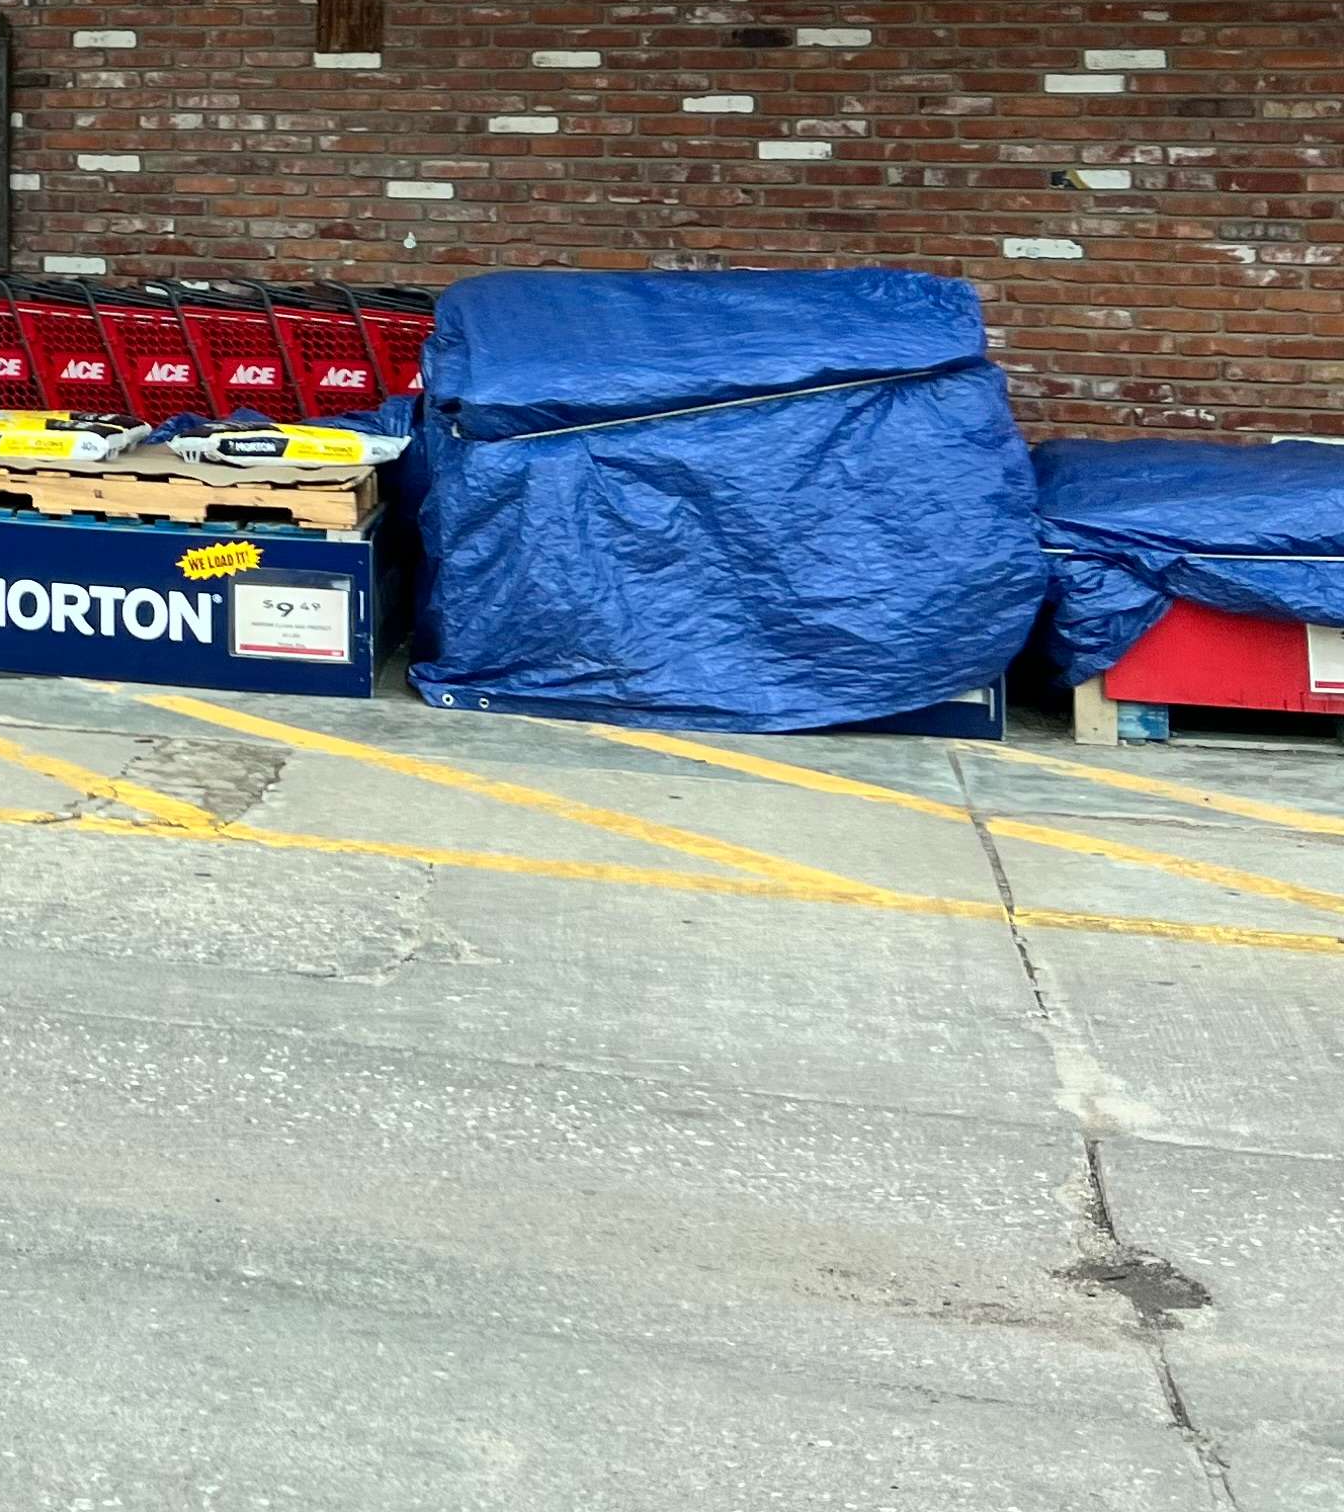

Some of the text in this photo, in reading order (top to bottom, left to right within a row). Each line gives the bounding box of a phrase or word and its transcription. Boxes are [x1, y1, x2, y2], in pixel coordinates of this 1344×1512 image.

[61, 359, 105, 380] ACE
[144, 361, 190, 382] ACE
[229, 364, 276, 385] ACE
[319, 367, 367, 388] ACE
[188, 551, 250, 571] WE LOAD IT!
